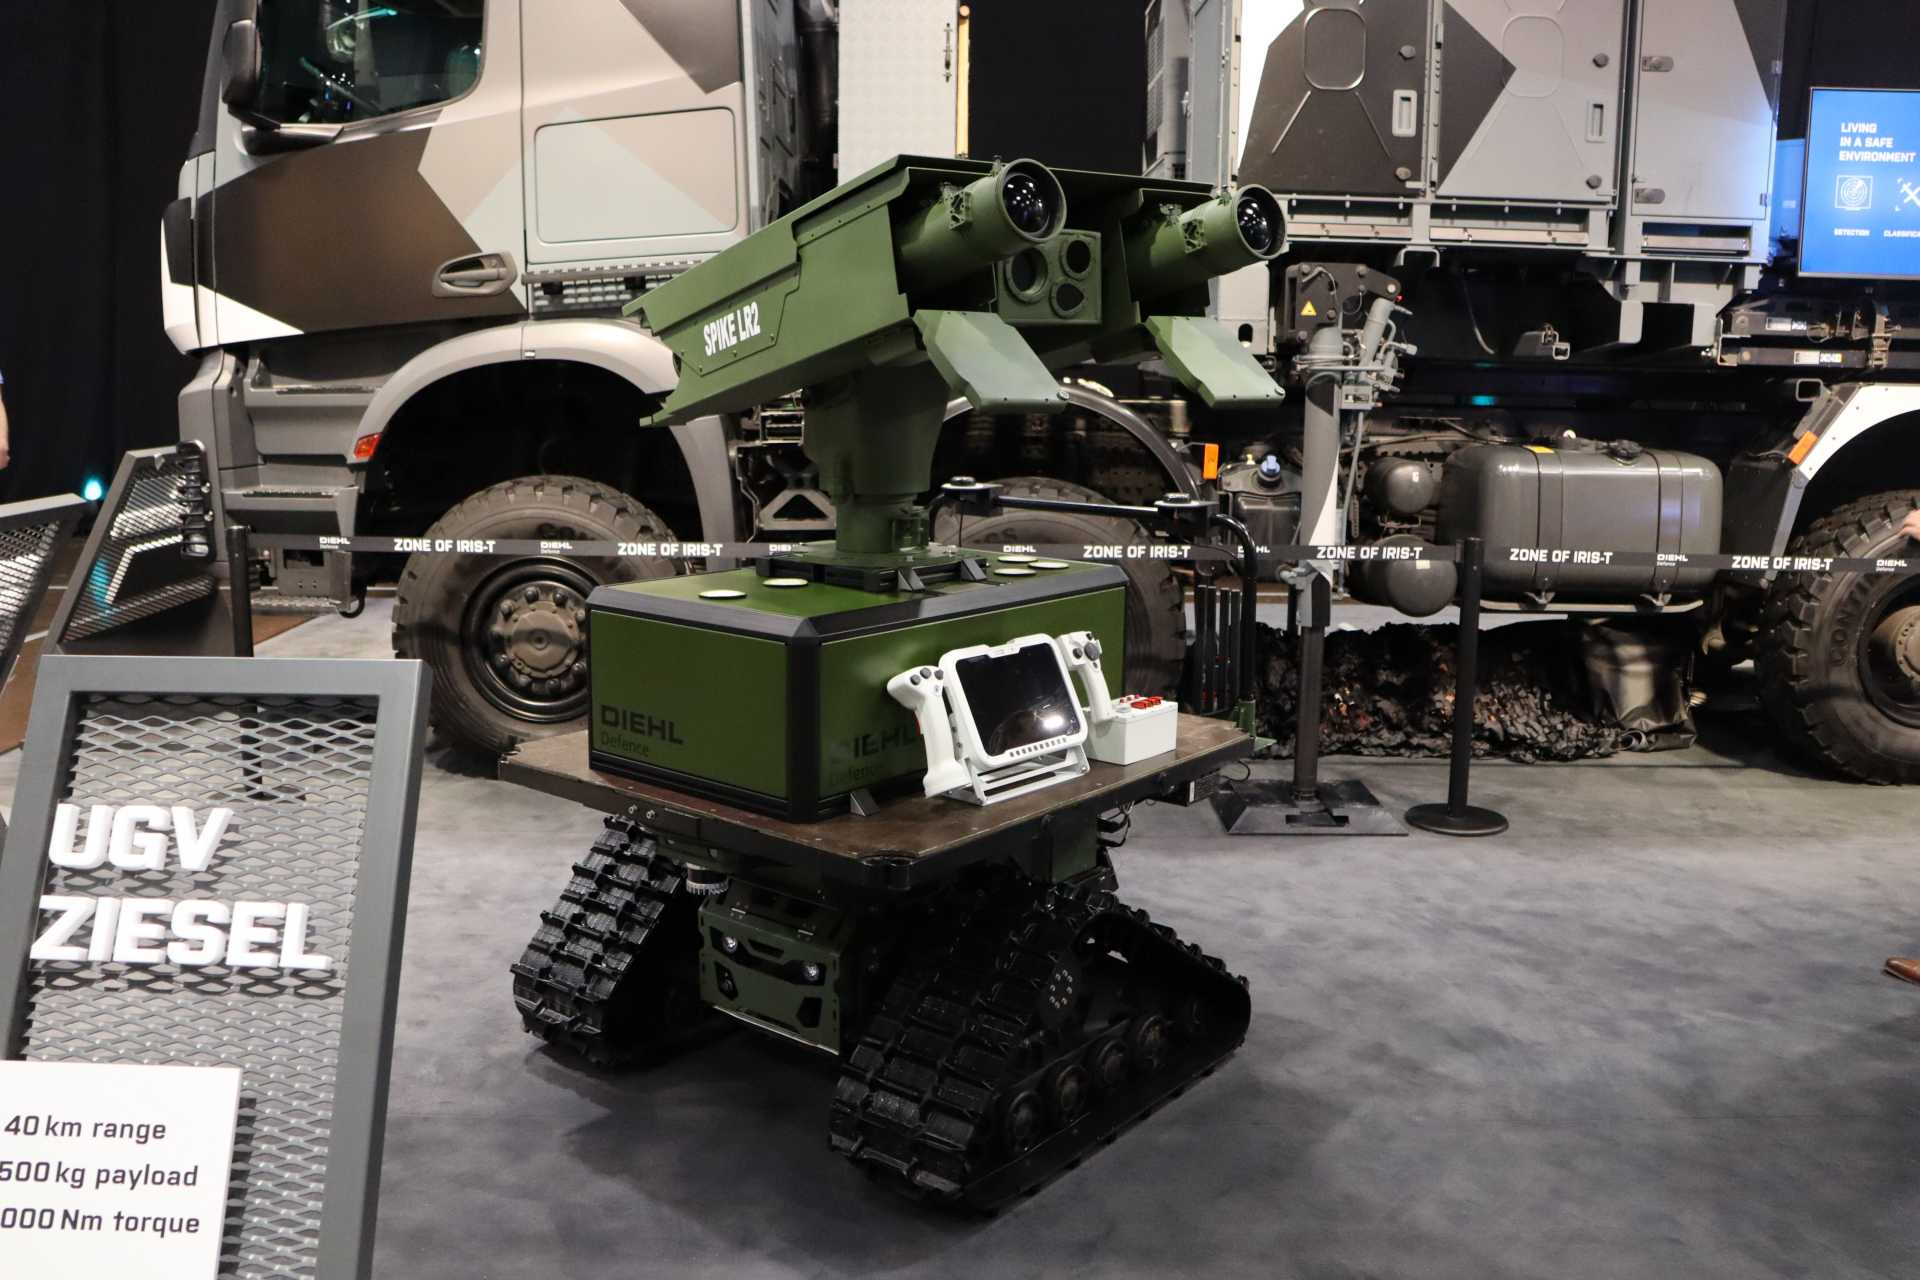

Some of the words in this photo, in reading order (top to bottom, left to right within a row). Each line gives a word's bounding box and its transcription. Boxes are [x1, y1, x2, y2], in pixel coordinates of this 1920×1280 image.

[1840, 122, 1878, 134] LIVING
[1839, 136, 1852, 147] IN
[1854, 137, 1862, 148] A
[1865, 137, 1894, 148] SAFE
[1839, 151, 1916, 162] ENVIRONMENT
[703, 312, 737, 356] SPIKE
[736, 301, 761, 342] LR2
[319, 536, 351, 545] DIEHL
[393, 538, 432, 552] ZONE
[435, 539, 453, 552] OF
[456, 540, 496, 553] IRIS-T
[540, 541, 573, 549] DIEHL
[617, 542, 656, 556] ZONE
[660, 543, 679, 556] OF
[682, 543, 723, 557] IRIS-T
[1083, 545, 1123, 558] ZONE
[1127, 545, 1146, 558] OF
[1150, 545, 1191, 559] IRIS-T
[1316, 546, 1356, 559] ZONE
[1360, 547, 1379, 559] OF
[1382, 547, 1423, 559] IRIS-T
[1510, 548, 1548, 562] ZONE
[1552, 549, 1571, 563] OF
[1573, 550, 1613, 564] IRIS-T
[1657, 553, 1688, 561] DIEHL
[1731, 556, 1770, 569] ZONE
[1773, 557, 1791, 569] OF
[1794, 558, 1834, 571] IRIS-T
[1876, 559, 1907, 567] DIEHL
[601, 704, 684, 745] DIEHL
[600, 731, 649, 757] Defence
[830, 723, 917, 763] IEHL
[48, 803, 234, 872] UGV
[29, 895, 333, 970] ZIESEL
[4, 1115, 40, 1136] 40
[45, 1115, 82, 1137] km
[92, 1121, 167, 1145] range
[0, 1161, 50, 1182] 500
[56, 1161, 86, 1189] kg
[95, 1163, 199, 1190] payload
[61, 1209, 103, 1231] Nm
[113, 1211, 200, 1238] torque
